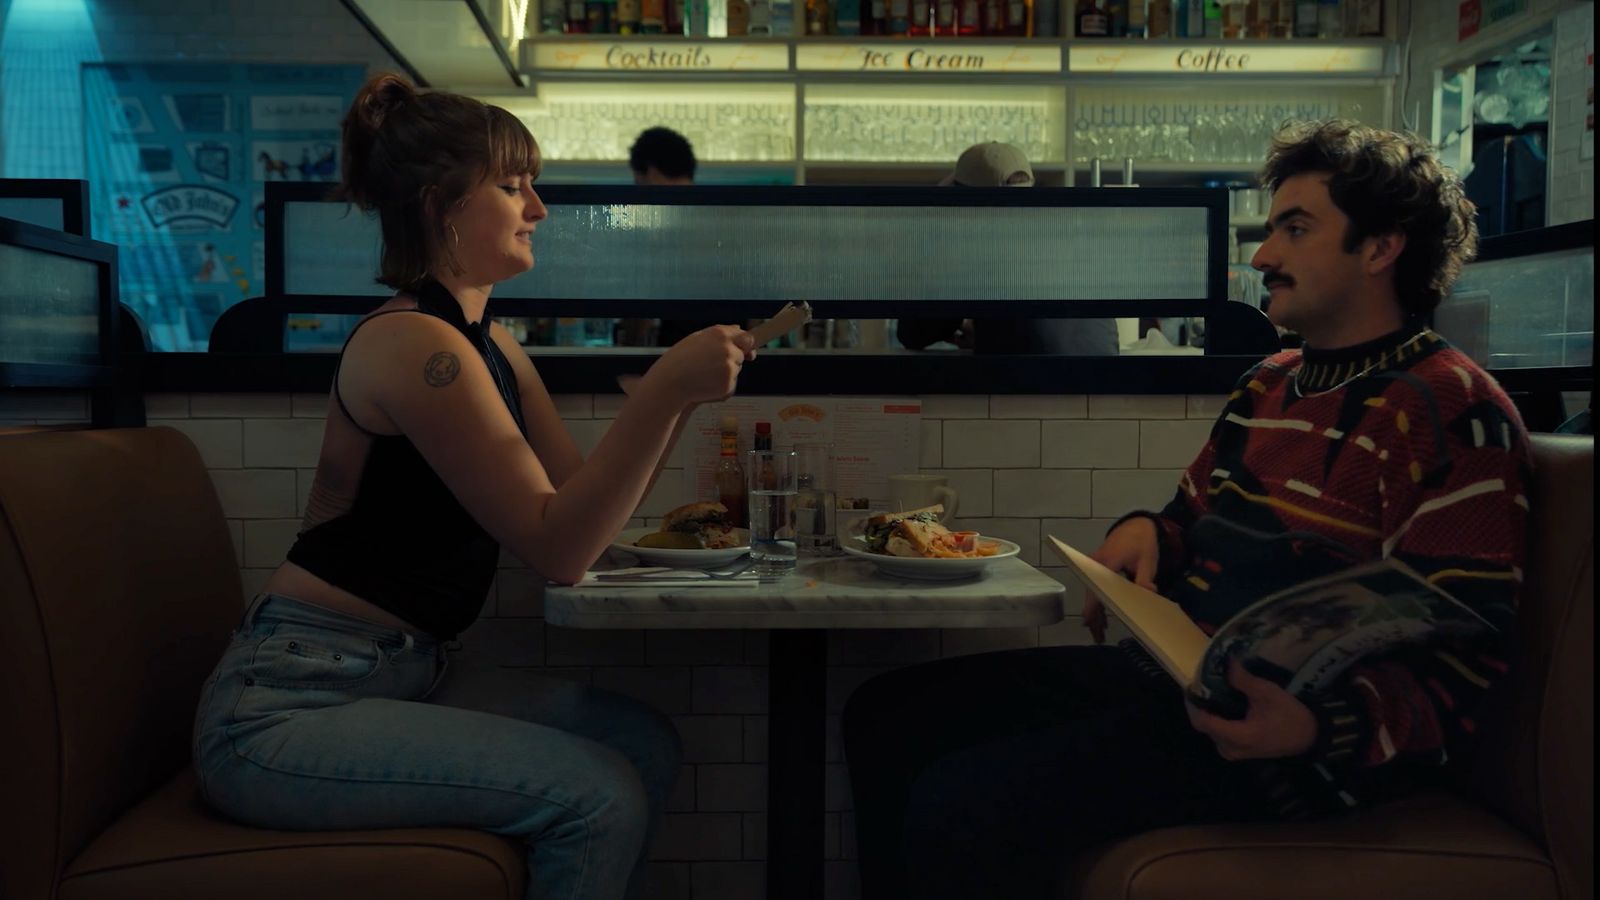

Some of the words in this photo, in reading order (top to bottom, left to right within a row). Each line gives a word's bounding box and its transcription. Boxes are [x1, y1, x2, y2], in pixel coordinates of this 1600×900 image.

[605, 45, 711, 68] Cocktails
[905, 48, 984, 69] Cream
[1176, 47, 1250, 72] Coffee
